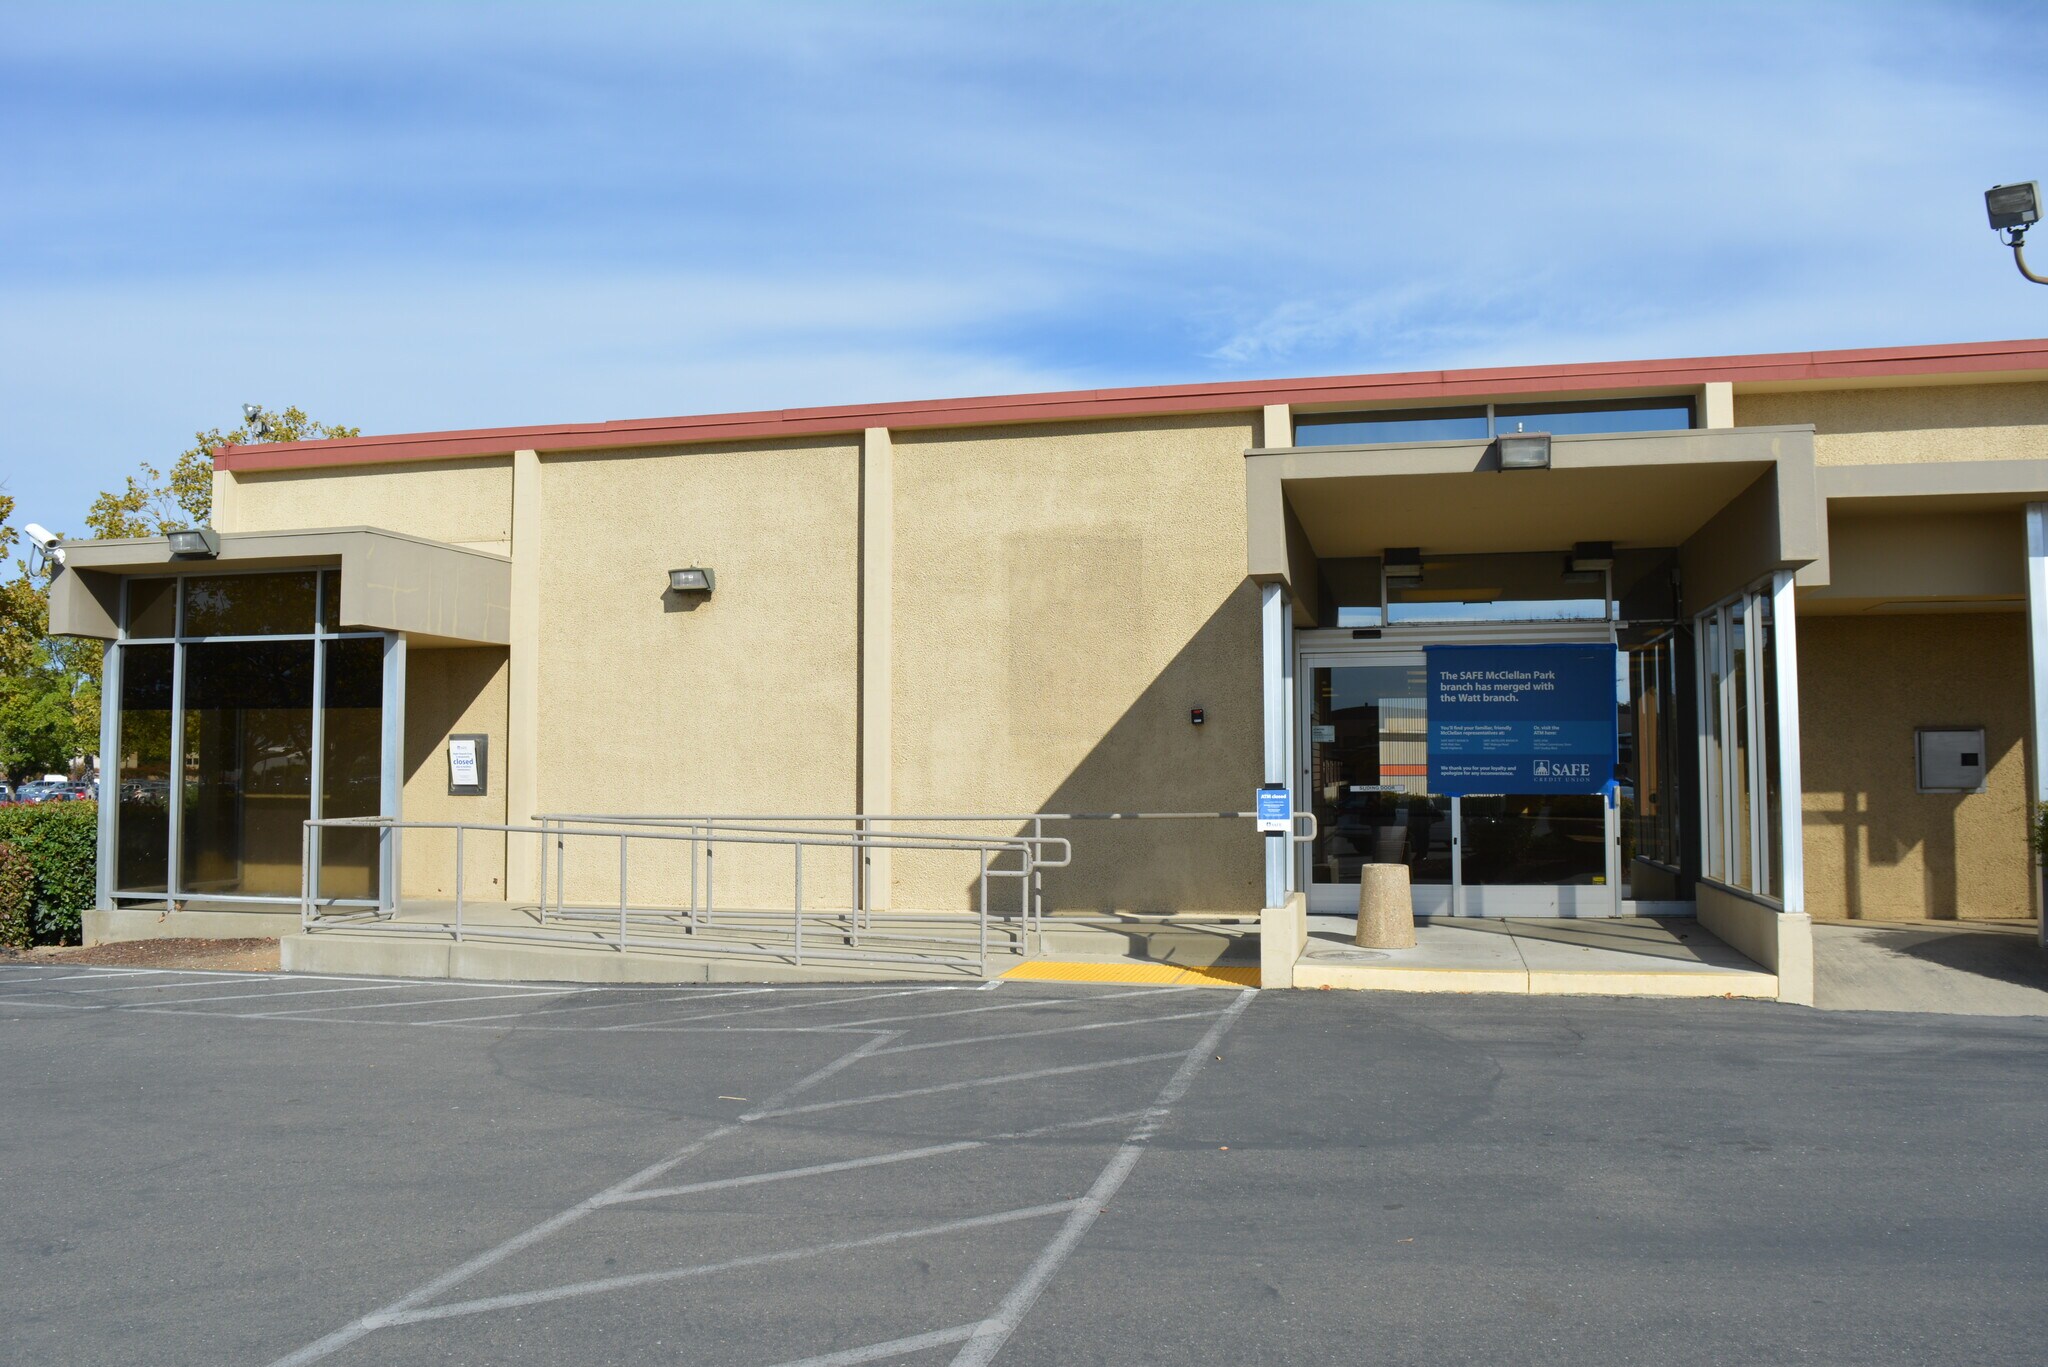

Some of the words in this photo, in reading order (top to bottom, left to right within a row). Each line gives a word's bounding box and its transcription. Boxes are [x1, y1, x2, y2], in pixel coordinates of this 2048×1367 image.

[1440, 671, 1458, 680] The
[1460, 671, 1483, 680] SAFE
[1486, 670, 1531, 680] McClellan
[1533, 670, 1555, 680] Park
[1440, 682, 1473, 691] branch
[1475, 682, 1491, 691] has
[1493, 682, 1530, 692] merged
[1533, 682, 1554, 690] with
[1440, 693, 1456, 702] the
[1458, 693, 1481, 702] Watt
[1483, 693, 1519, 702] branch.
[1552, 763, 1591, 776] SAFE
